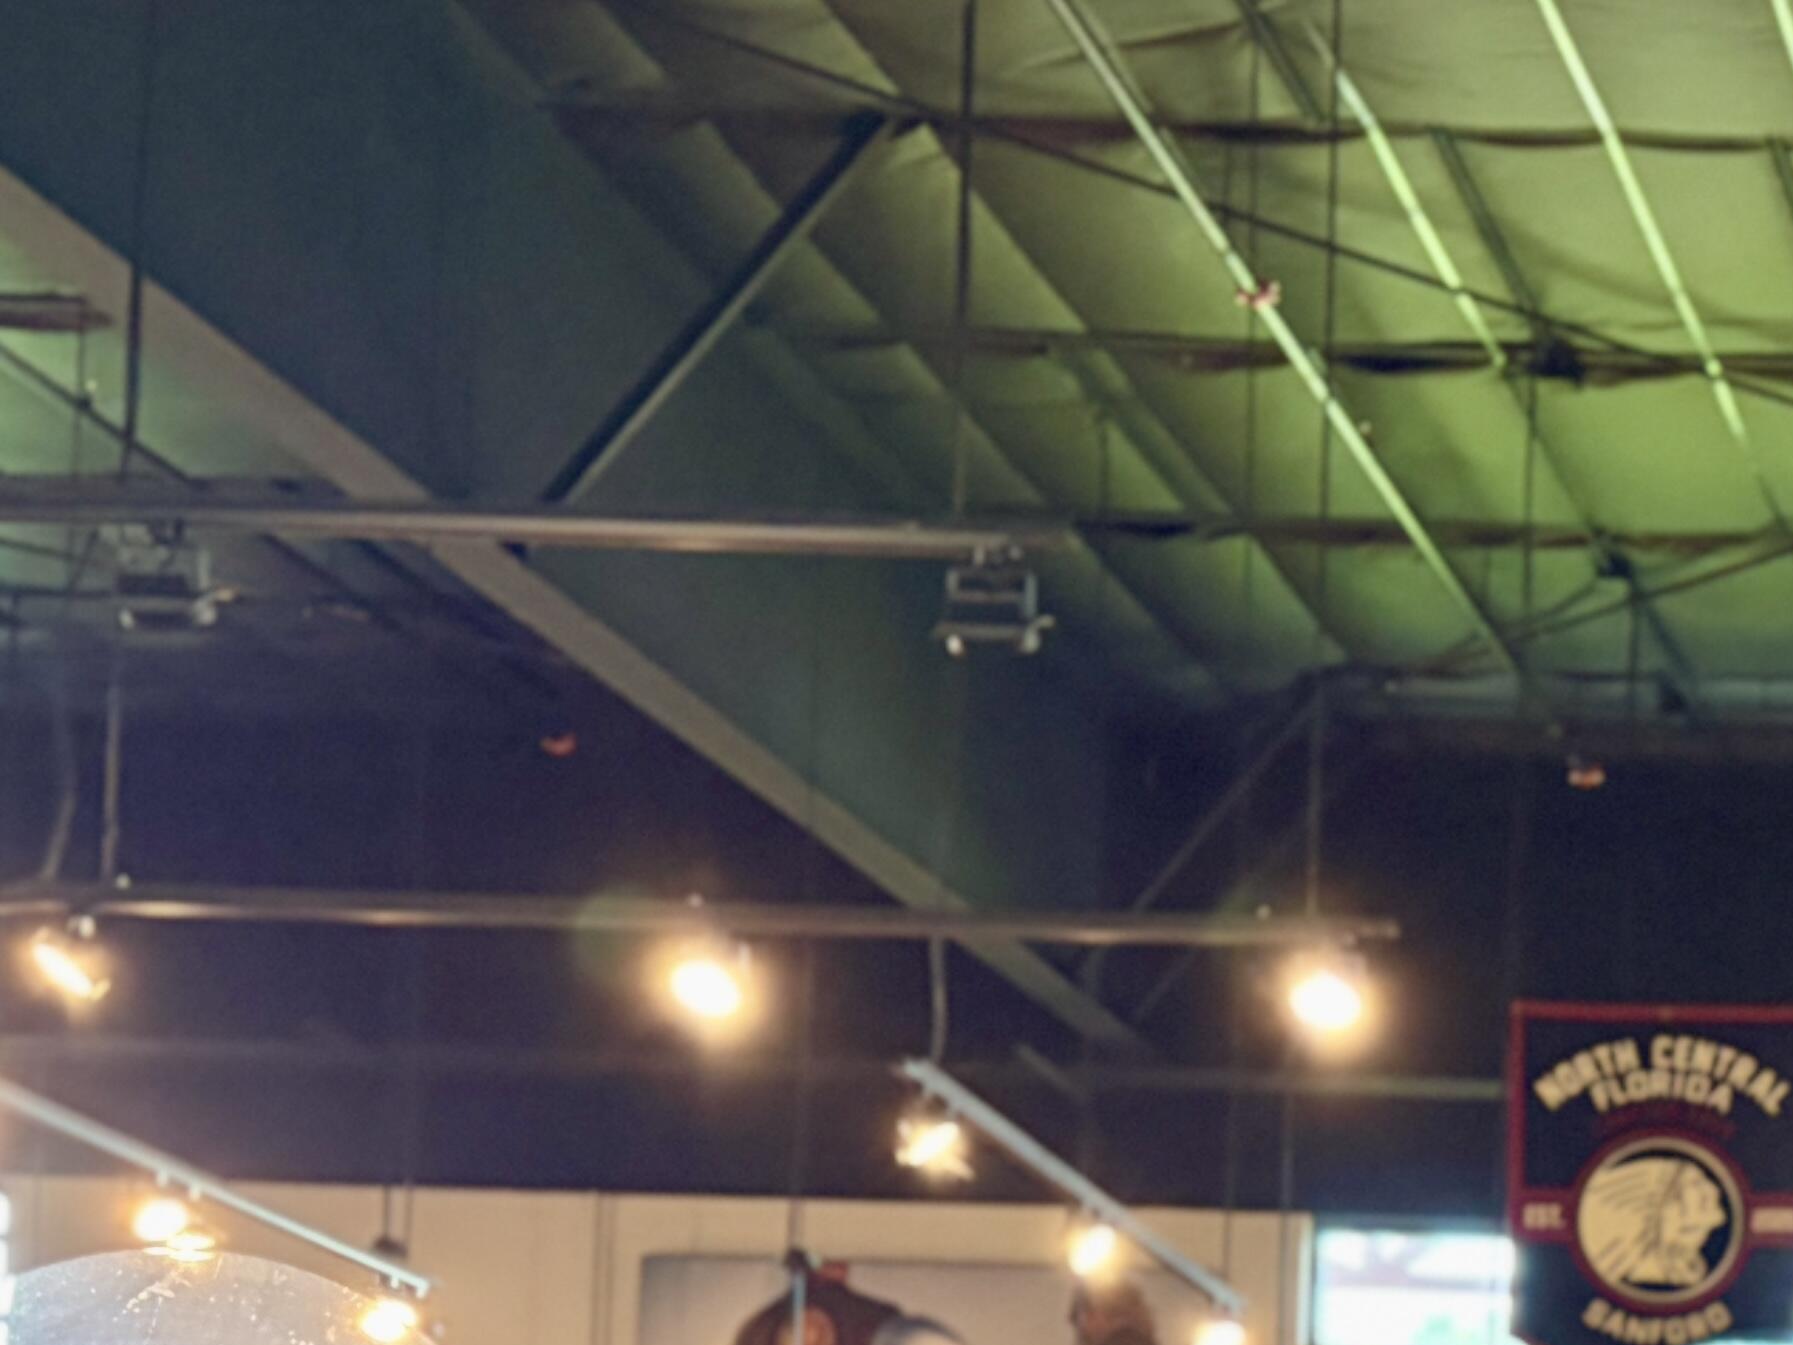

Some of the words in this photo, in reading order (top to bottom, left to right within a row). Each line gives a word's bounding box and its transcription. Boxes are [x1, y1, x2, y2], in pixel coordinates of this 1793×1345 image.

[1533, 1037, 1642, 1112] NORTH
[1650, 1034, 1792, 1116] CENTRAL
[1589, 1069, 1734, 1116] FLORIDA
